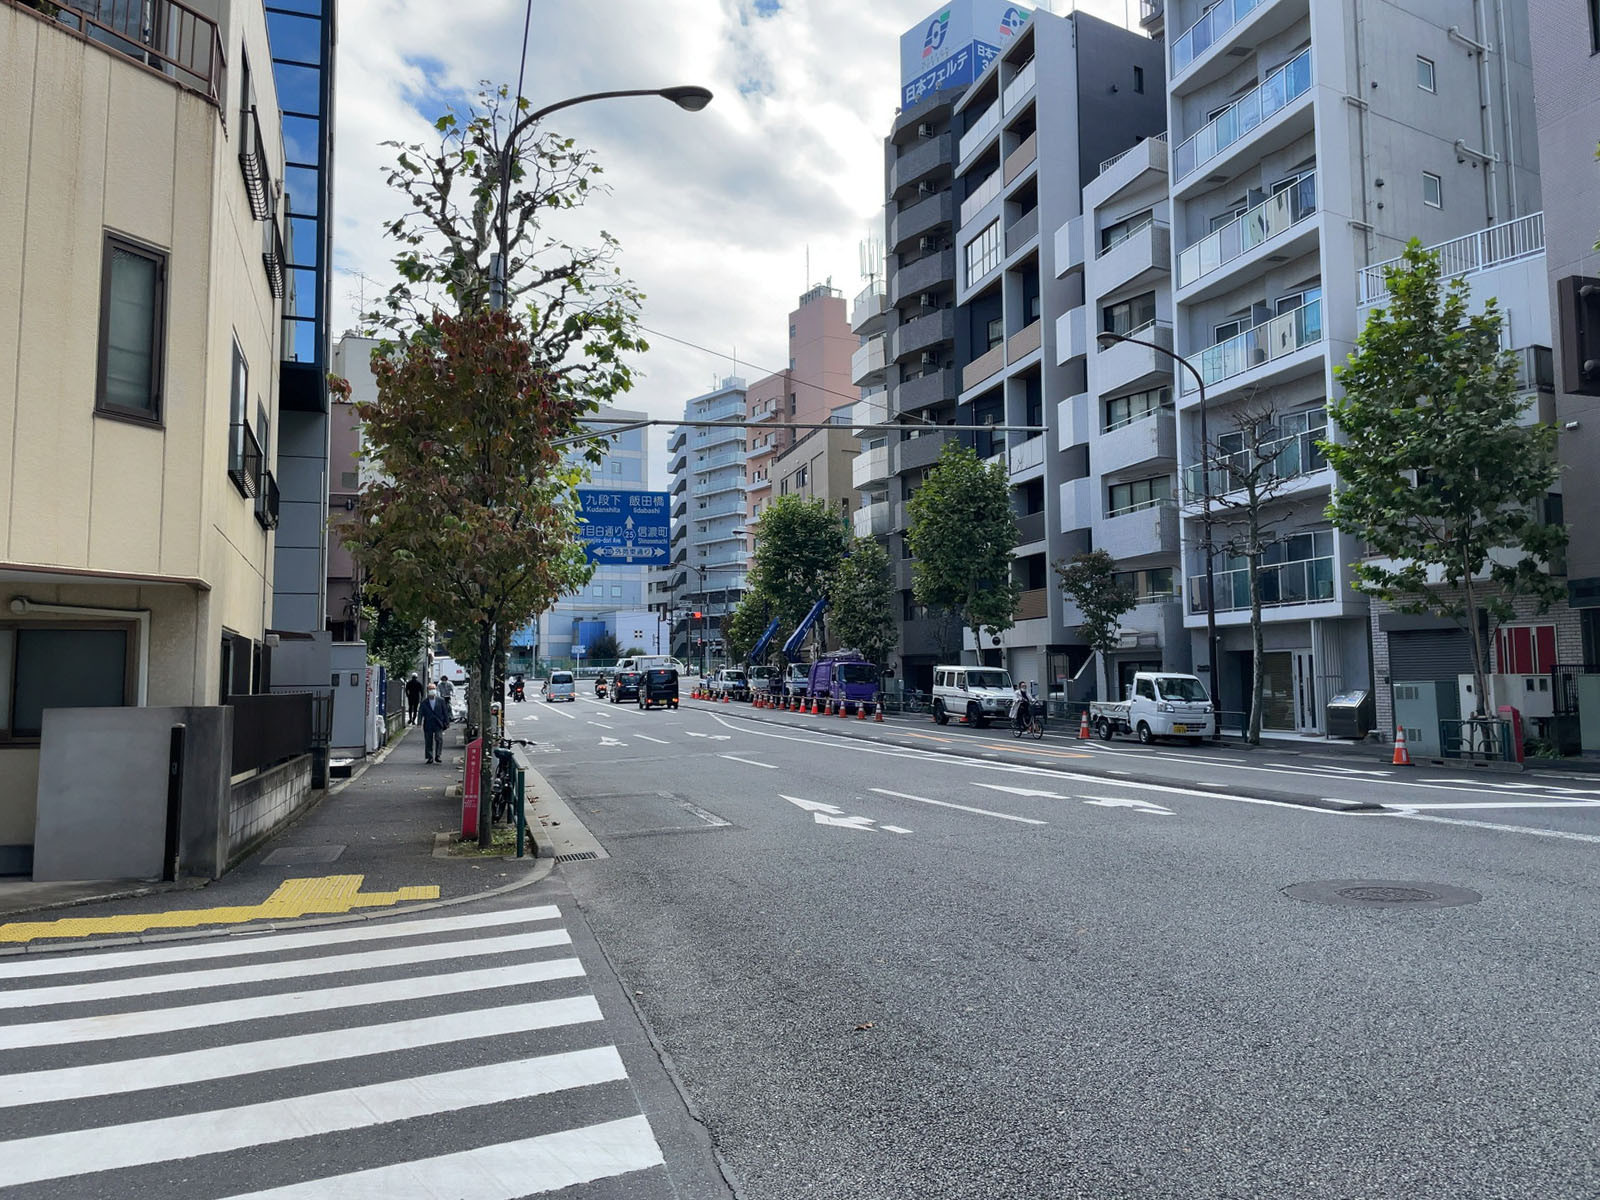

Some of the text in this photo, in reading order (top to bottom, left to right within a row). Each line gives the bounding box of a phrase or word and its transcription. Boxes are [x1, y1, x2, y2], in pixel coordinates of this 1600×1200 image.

[586, 494, 622, 506] 九段下
[629, 495, 664, 507] 飯田橋
[637, 526, 668, 538] 信濃町
